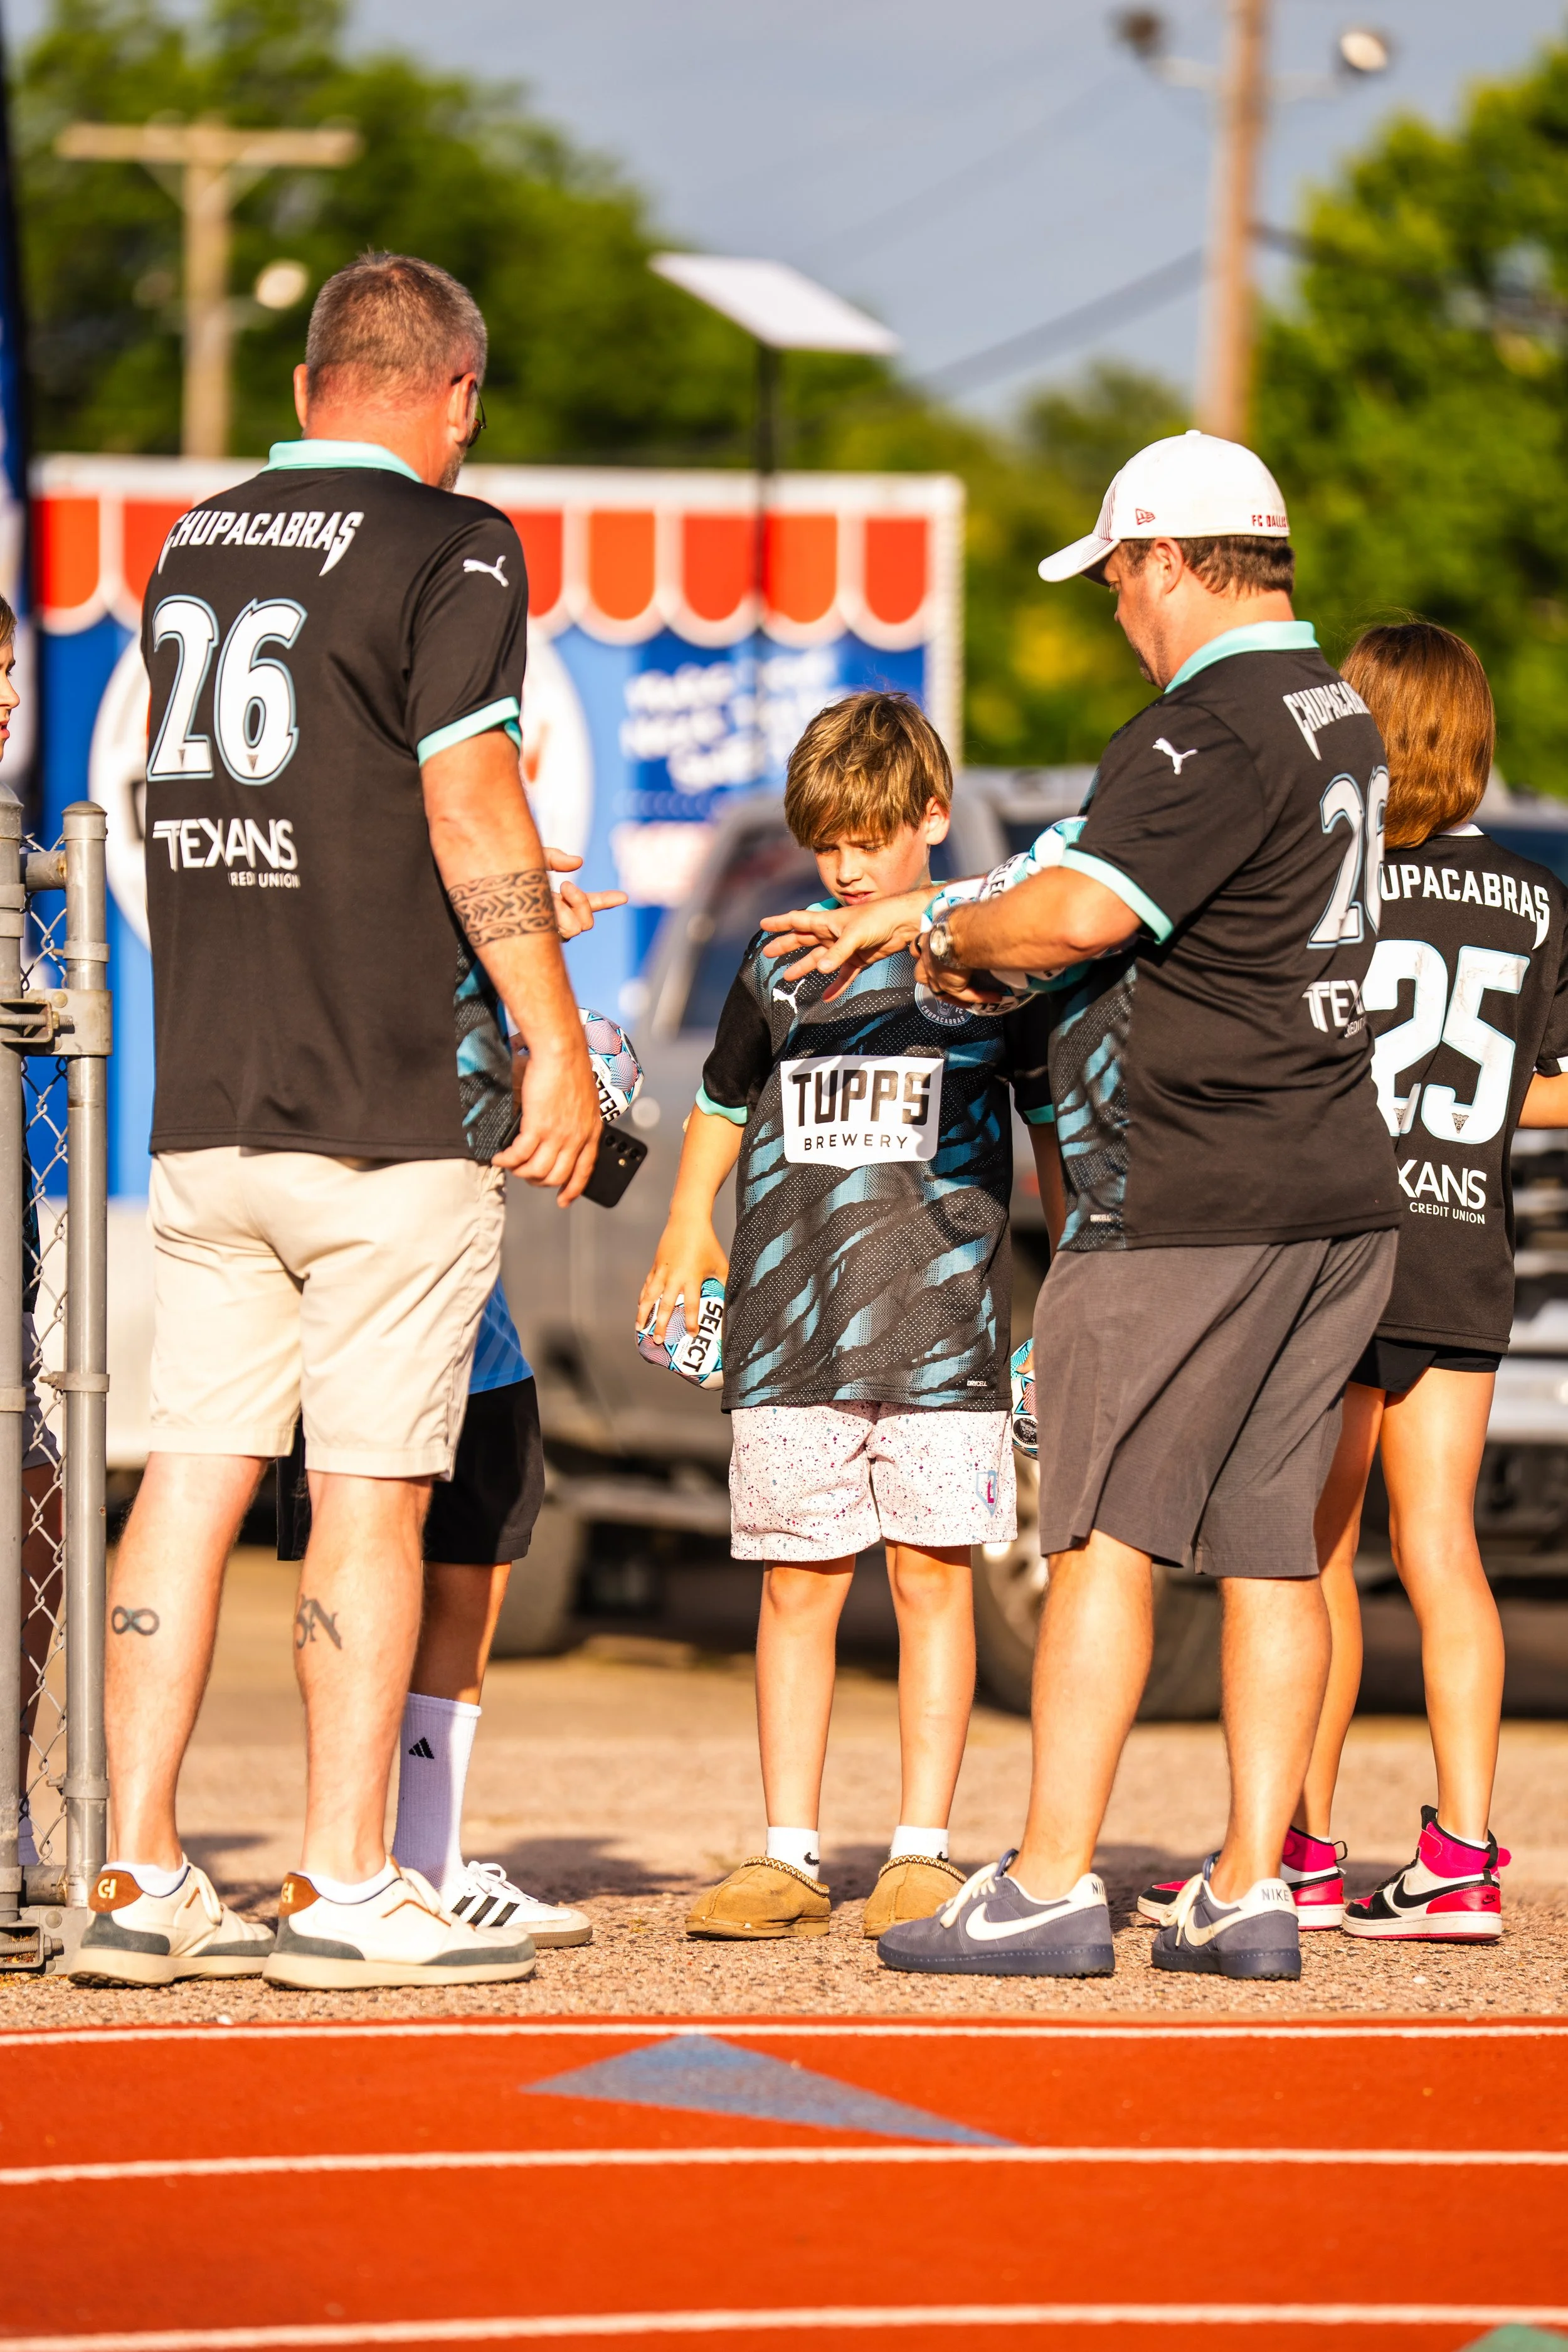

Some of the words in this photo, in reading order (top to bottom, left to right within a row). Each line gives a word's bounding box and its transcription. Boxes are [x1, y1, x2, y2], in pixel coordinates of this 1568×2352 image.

[158, 511, 364, 576] CHUPACABRAS
[1251, 514, 1263, 527] FC
[1266, 514, 1287, 527] DALLA
[147, 595, 307, 785] 26
[1283, 681, 1370, 761] CHUPACAB
[152, 817, 298, 872] TEXANS
[258, 872, 301, 889] UNION
[1380, 864, 1550, 950] UPACABRAS
[921, 1005, 965, 1024] CHUPACABRAS
[1302, 980, 1365, 1032] TEX
[1362, 940, 1530, 1144] 25
[792, 1069, 931, 1127] TUPPS
[804, 1133, 908, 1151] BREWERY
[1397, 1159, 1487, 1210] XANS
[1409, 1202, 1449, 1217] CREDIT
[1453, 1208, 1485, 1224] UNION
[682, 1301, 723, 1372] SELECT
[1261, 1888, 1290, 1901] NIKE
